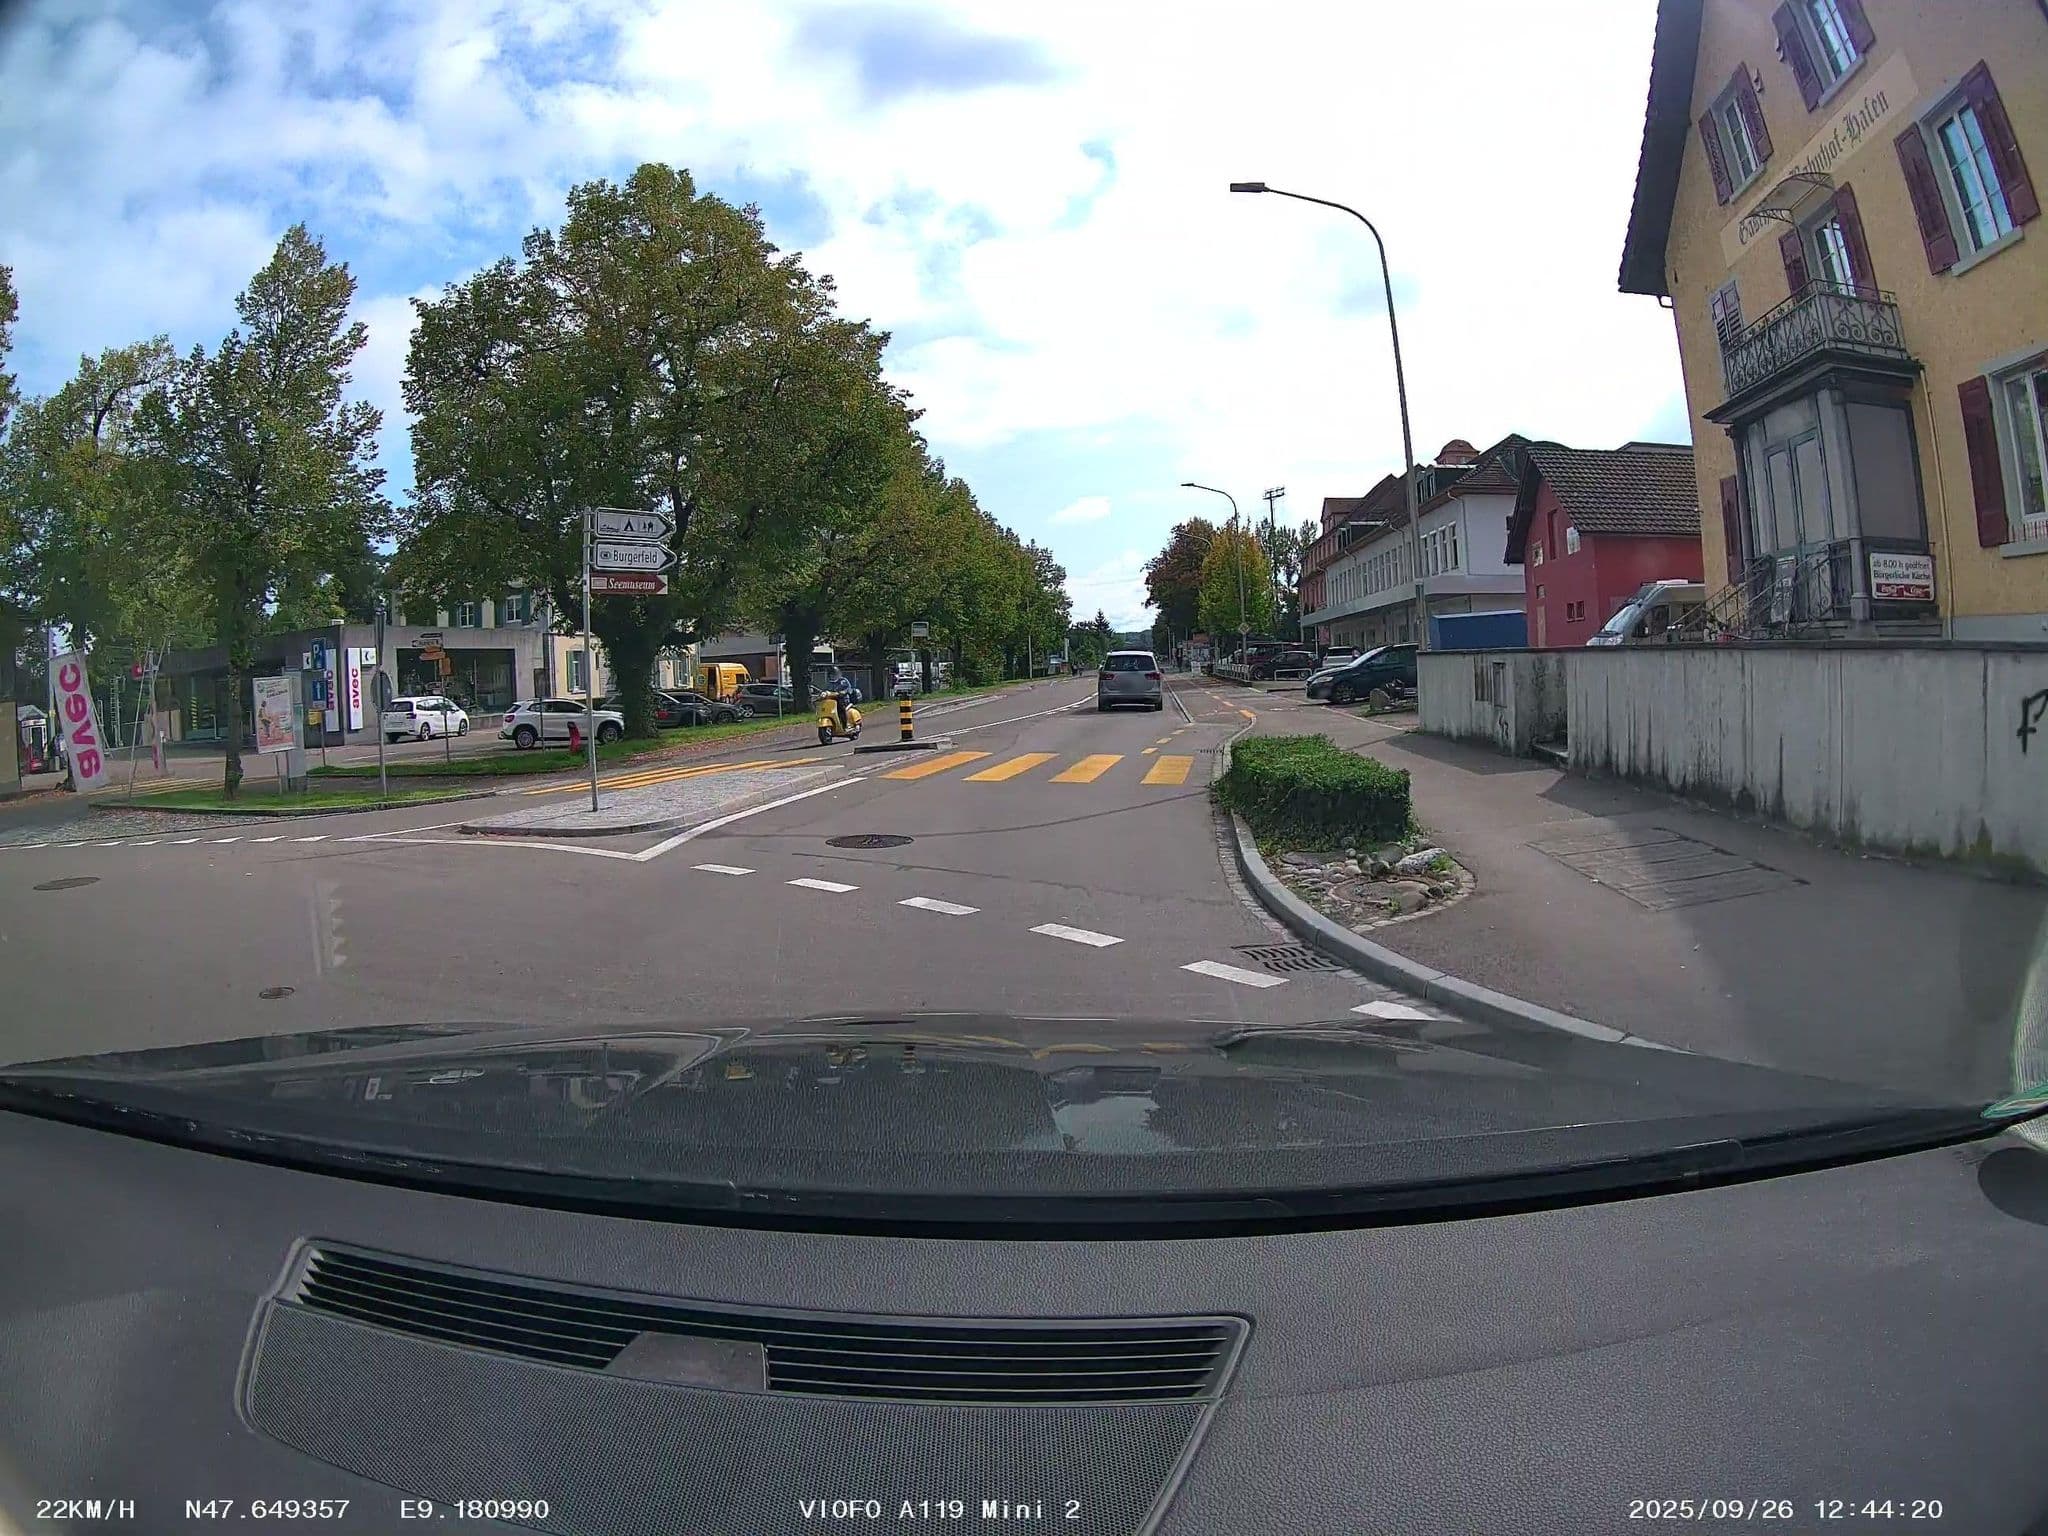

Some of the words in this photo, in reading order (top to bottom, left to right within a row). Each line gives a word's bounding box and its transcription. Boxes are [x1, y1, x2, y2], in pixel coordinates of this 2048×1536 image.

[1790, 90, 1889, 174] hnhof-Hafen
[608, 578, 656, 590] Seemuseum
[352, 668, 360, 709] avec
[59, 663, 101, 779] avec
